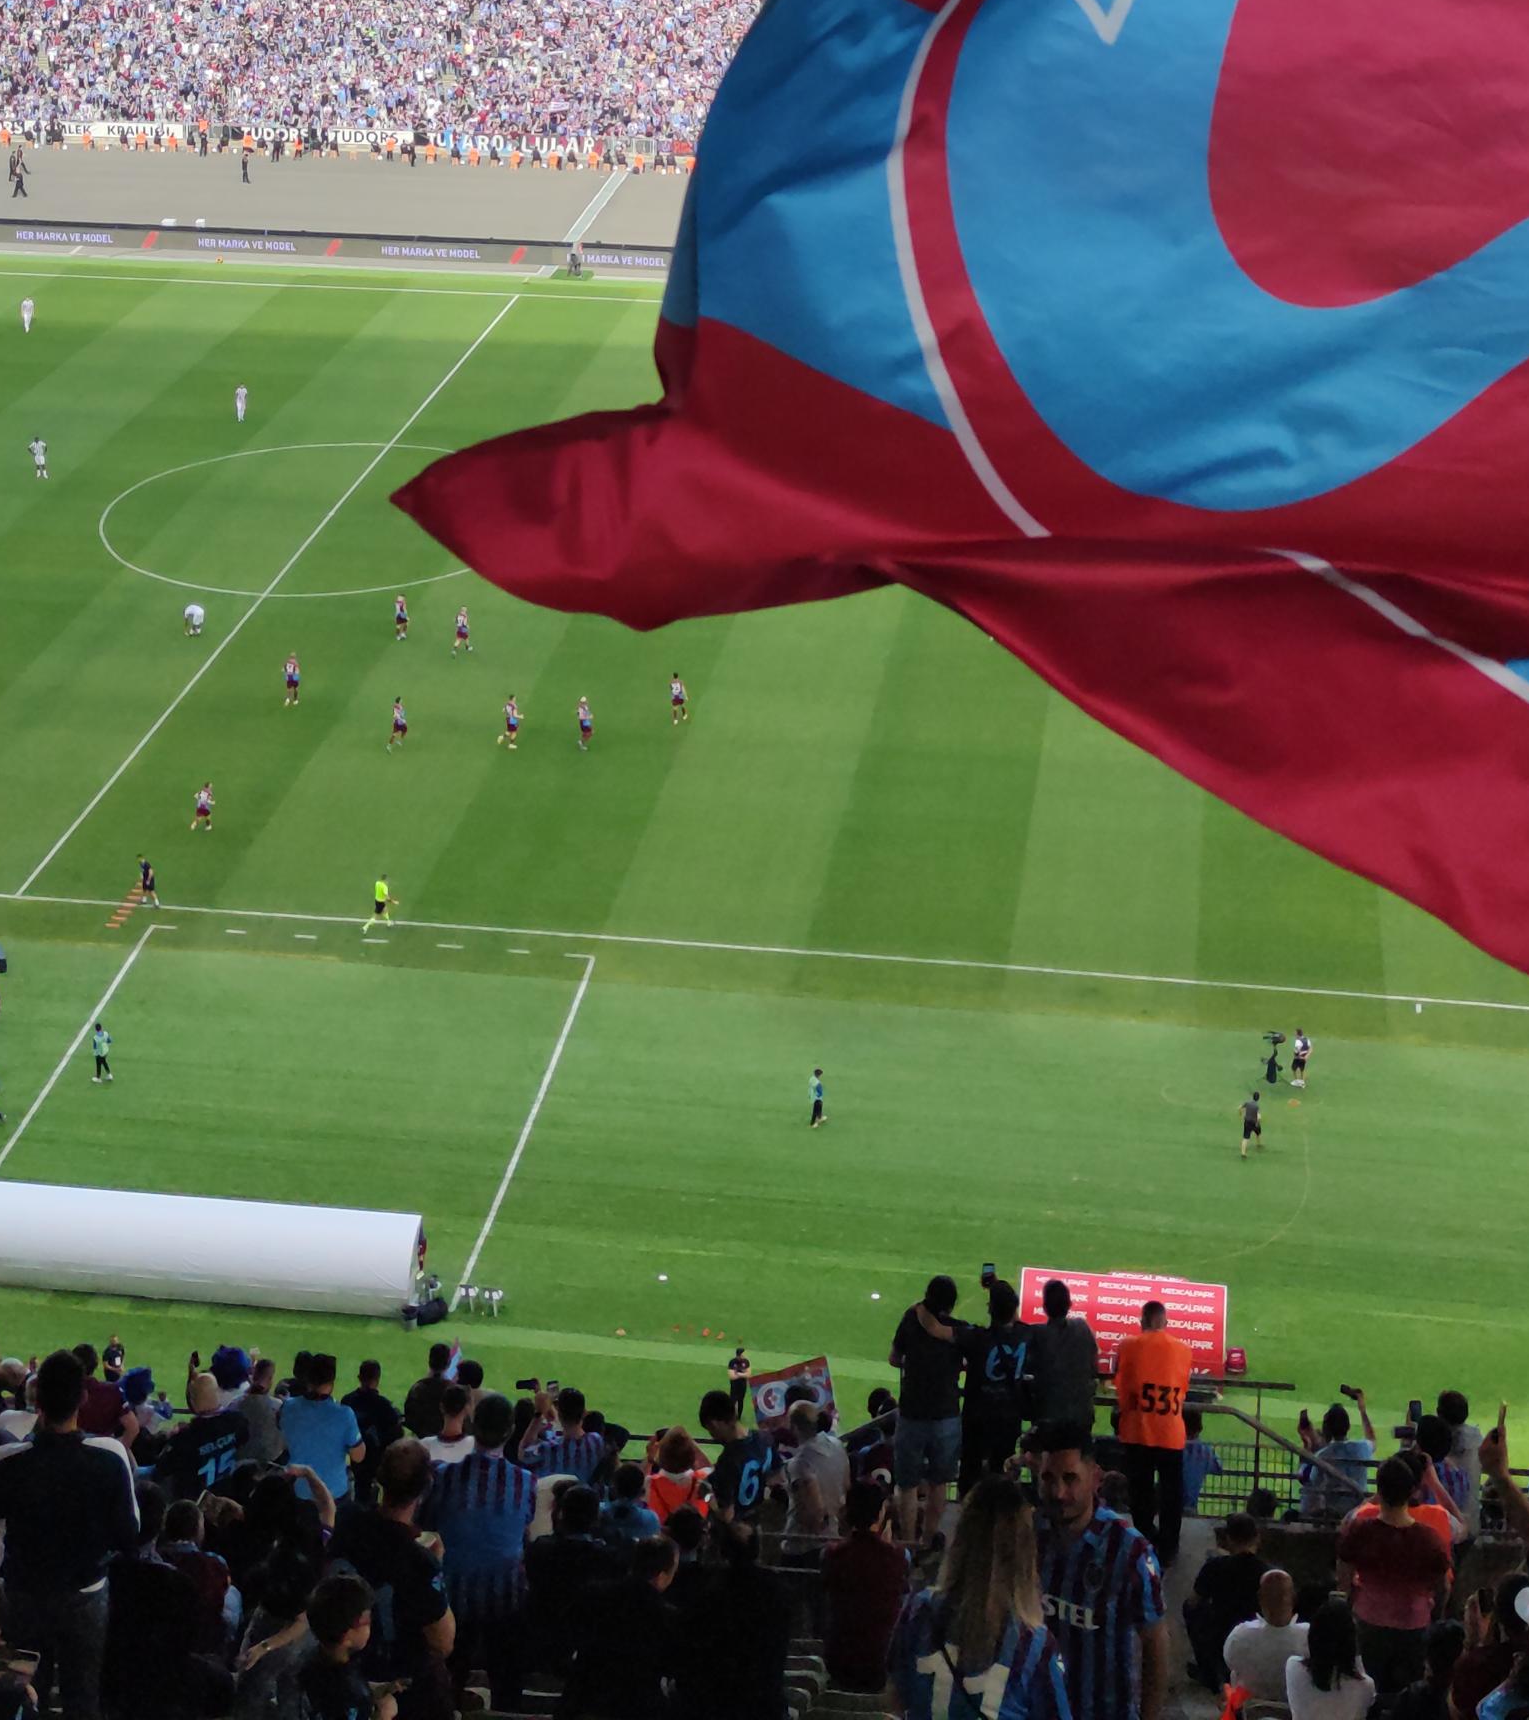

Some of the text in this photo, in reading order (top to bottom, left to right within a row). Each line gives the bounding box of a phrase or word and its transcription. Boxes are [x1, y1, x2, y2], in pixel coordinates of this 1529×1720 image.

[16, 231, 114, 244] HER MARKA VE MODEL
[198, 238, 296, 253] HER MARKA VE MODEL
[381, 245, 481, 260] HER MARKA VE MODEL
[587, 254, 620, 265] MARKA
[621, 256, 633, 266] VE
[635, 256, 667, 267] MODEL
[1041, 1593, 1100, 1630] STEL
